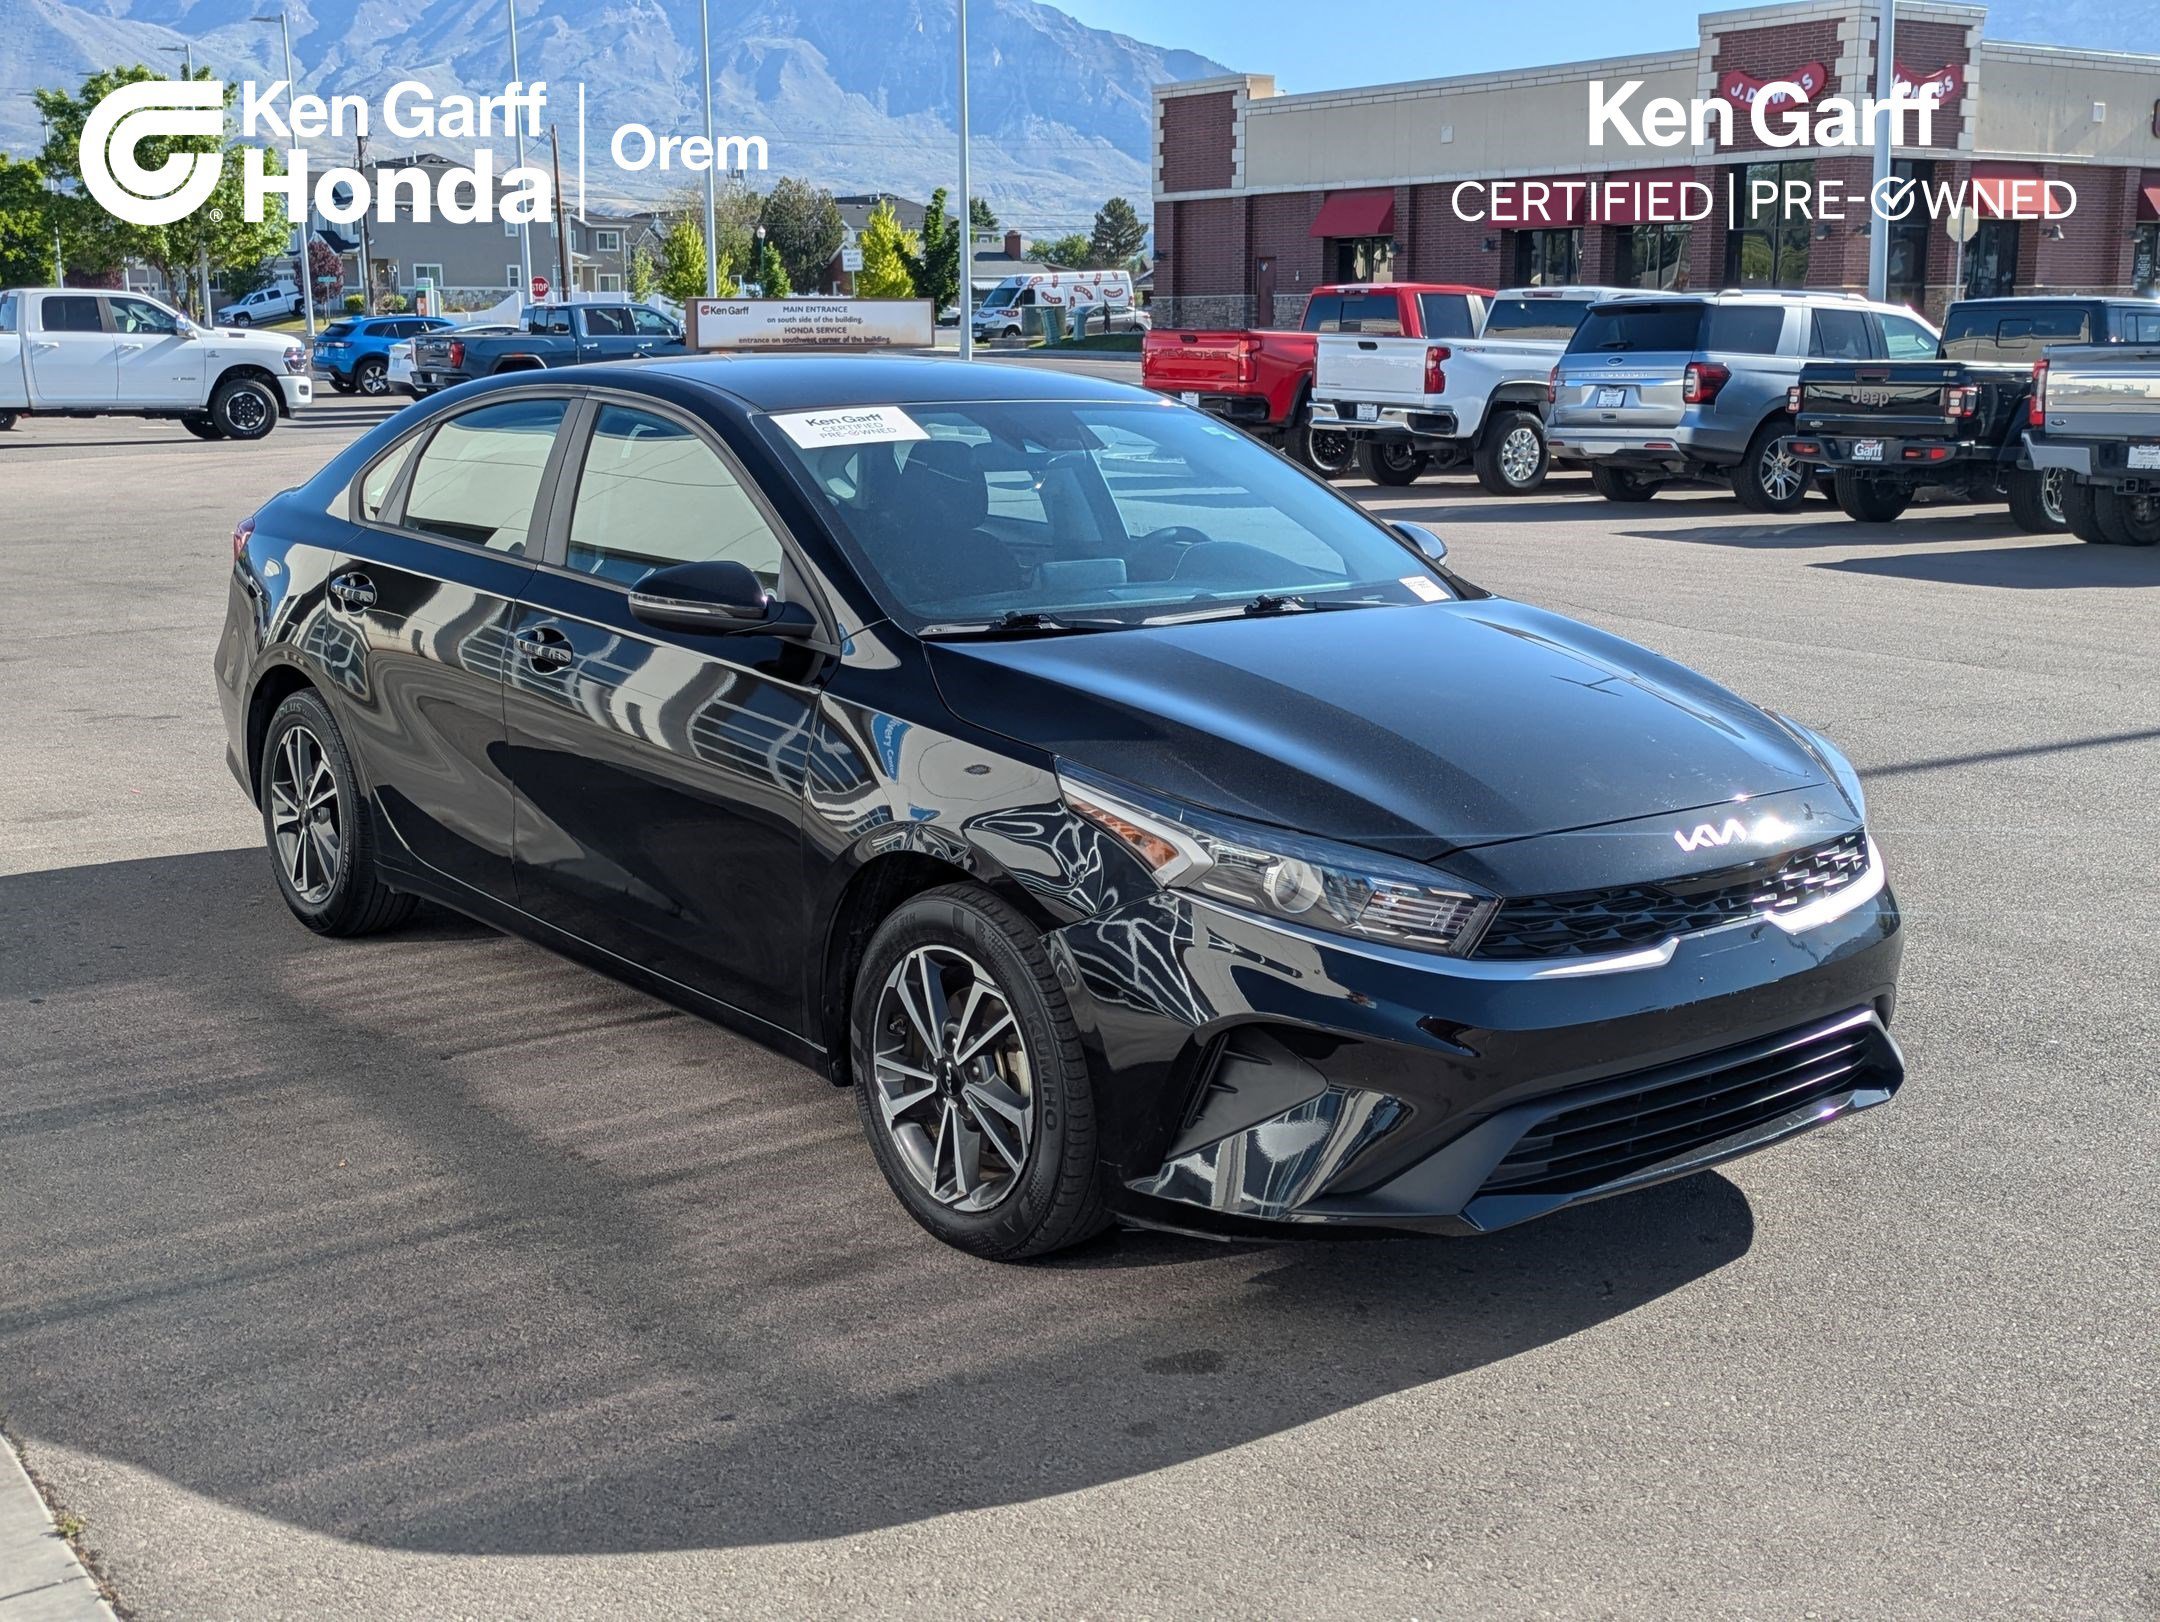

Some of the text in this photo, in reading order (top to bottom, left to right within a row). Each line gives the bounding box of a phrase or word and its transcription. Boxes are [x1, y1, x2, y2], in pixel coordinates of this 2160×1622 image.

[532, 282, 548, 291] STOP
[710, 306, 750, 316] Ken Garff
[1851, 390, 1889, 407] Jeep
[805, 414, 883, 427] Ken Garff
[822, 422, 884, 433] CERTIFIED
[1855, 443, 1883, 456] Garff
[1026, 1013, 1058, 1132] KUMHO
